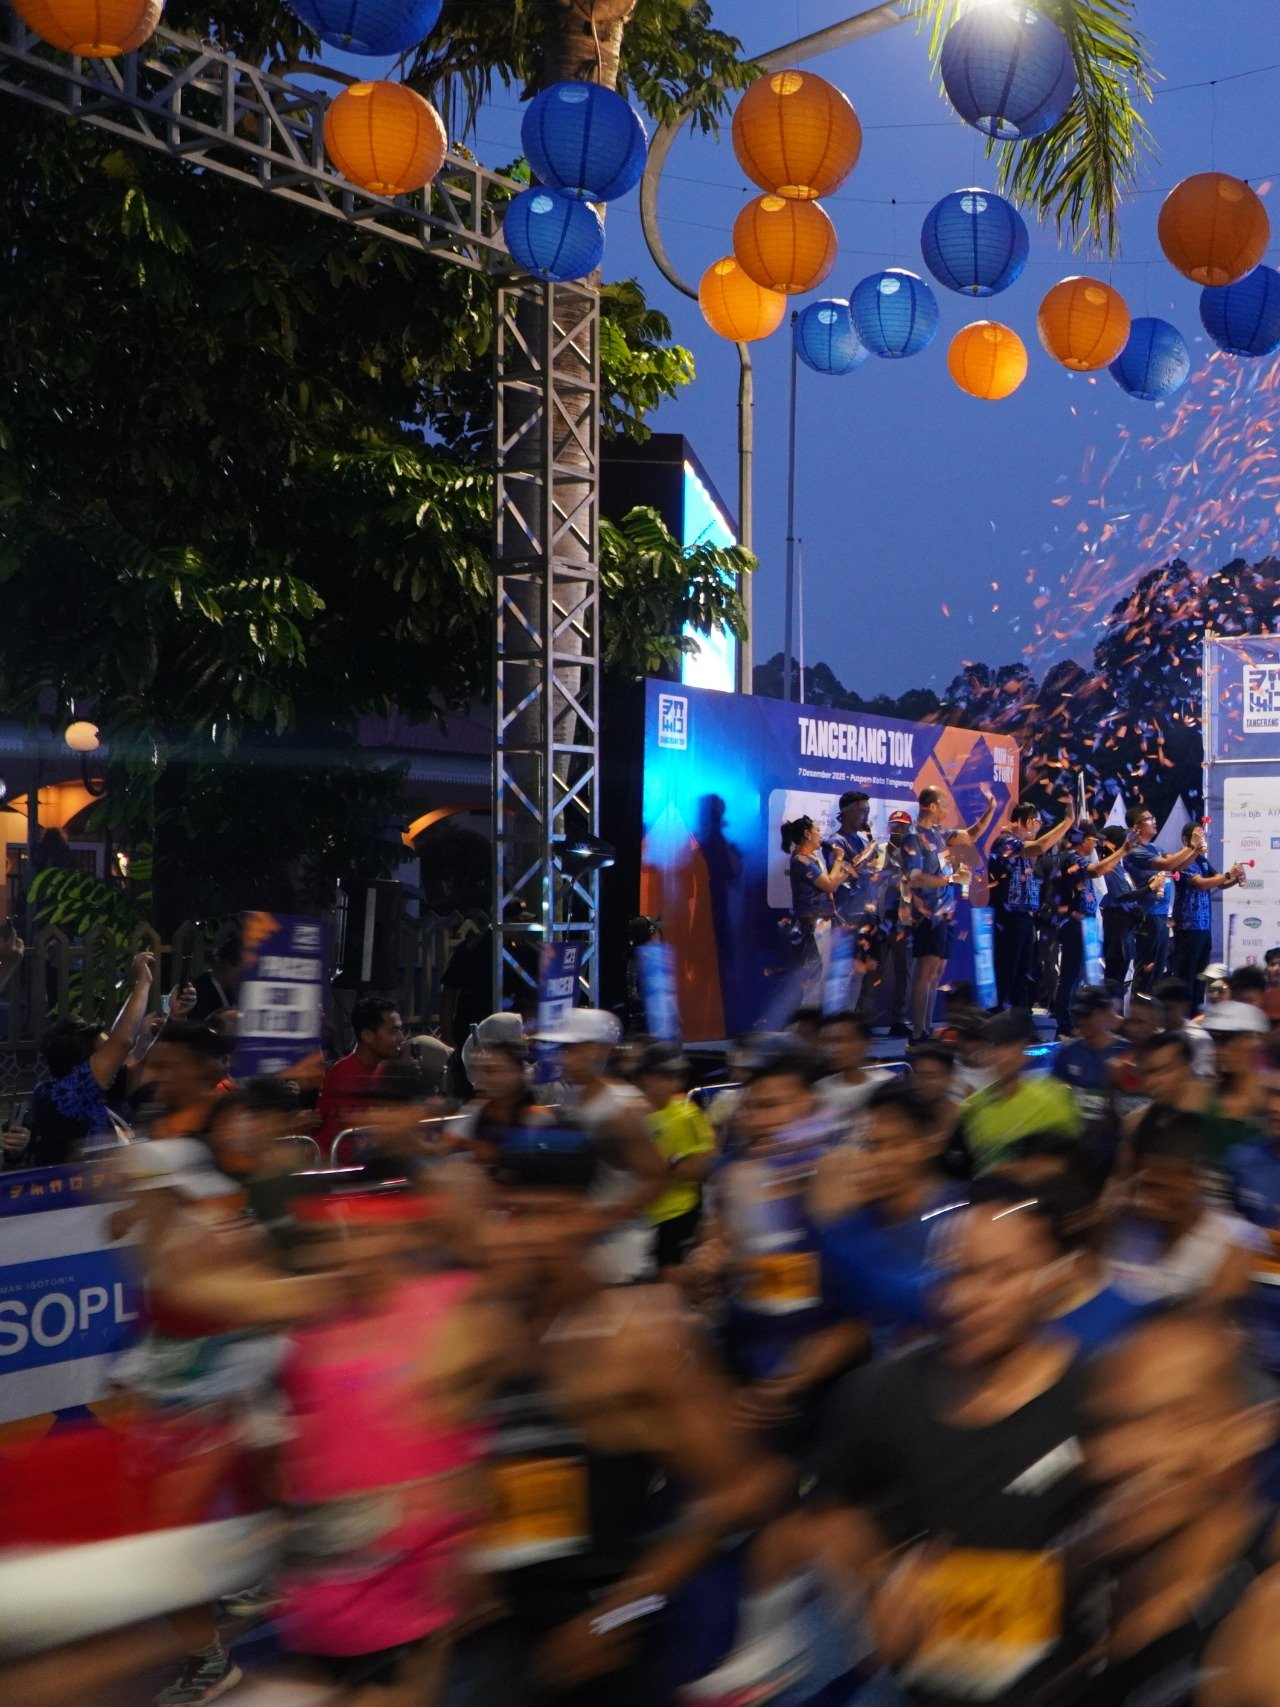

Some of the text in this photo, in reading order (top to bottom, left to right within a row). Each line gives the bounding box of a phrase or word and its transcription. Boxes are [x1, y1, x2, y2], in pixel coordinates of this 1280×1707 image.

[1246, 718, 1279, 728] TANGERANG
[798, 717, 914, 768] TANGERANG 10K
[803, 768, 831, 779] Desember
[1248, 809, 1261, 819] bjb
